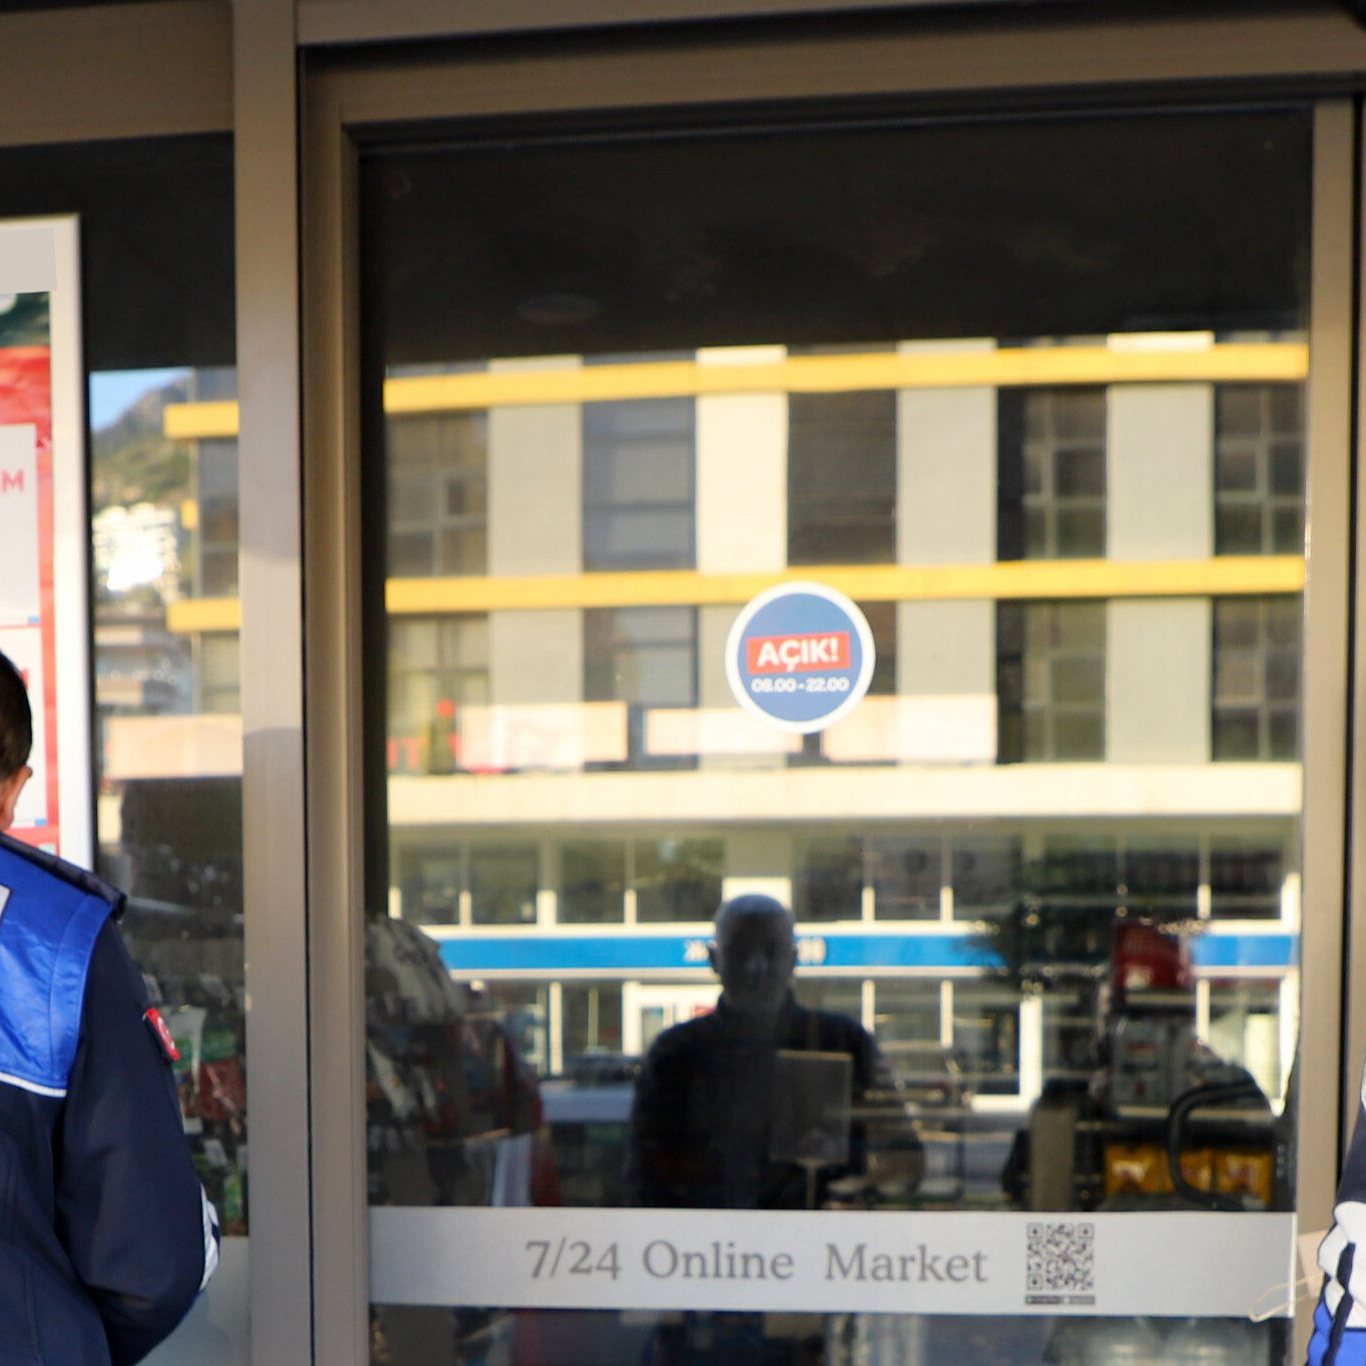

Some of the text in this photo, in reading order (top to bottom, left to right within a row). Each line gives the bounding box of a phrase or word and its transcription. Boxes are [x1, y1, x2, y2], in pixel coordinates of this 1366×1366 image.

[756, 636, 840, 673] AÇIK!
[525, 1237, 989, 1283] 7/24 Online Market
